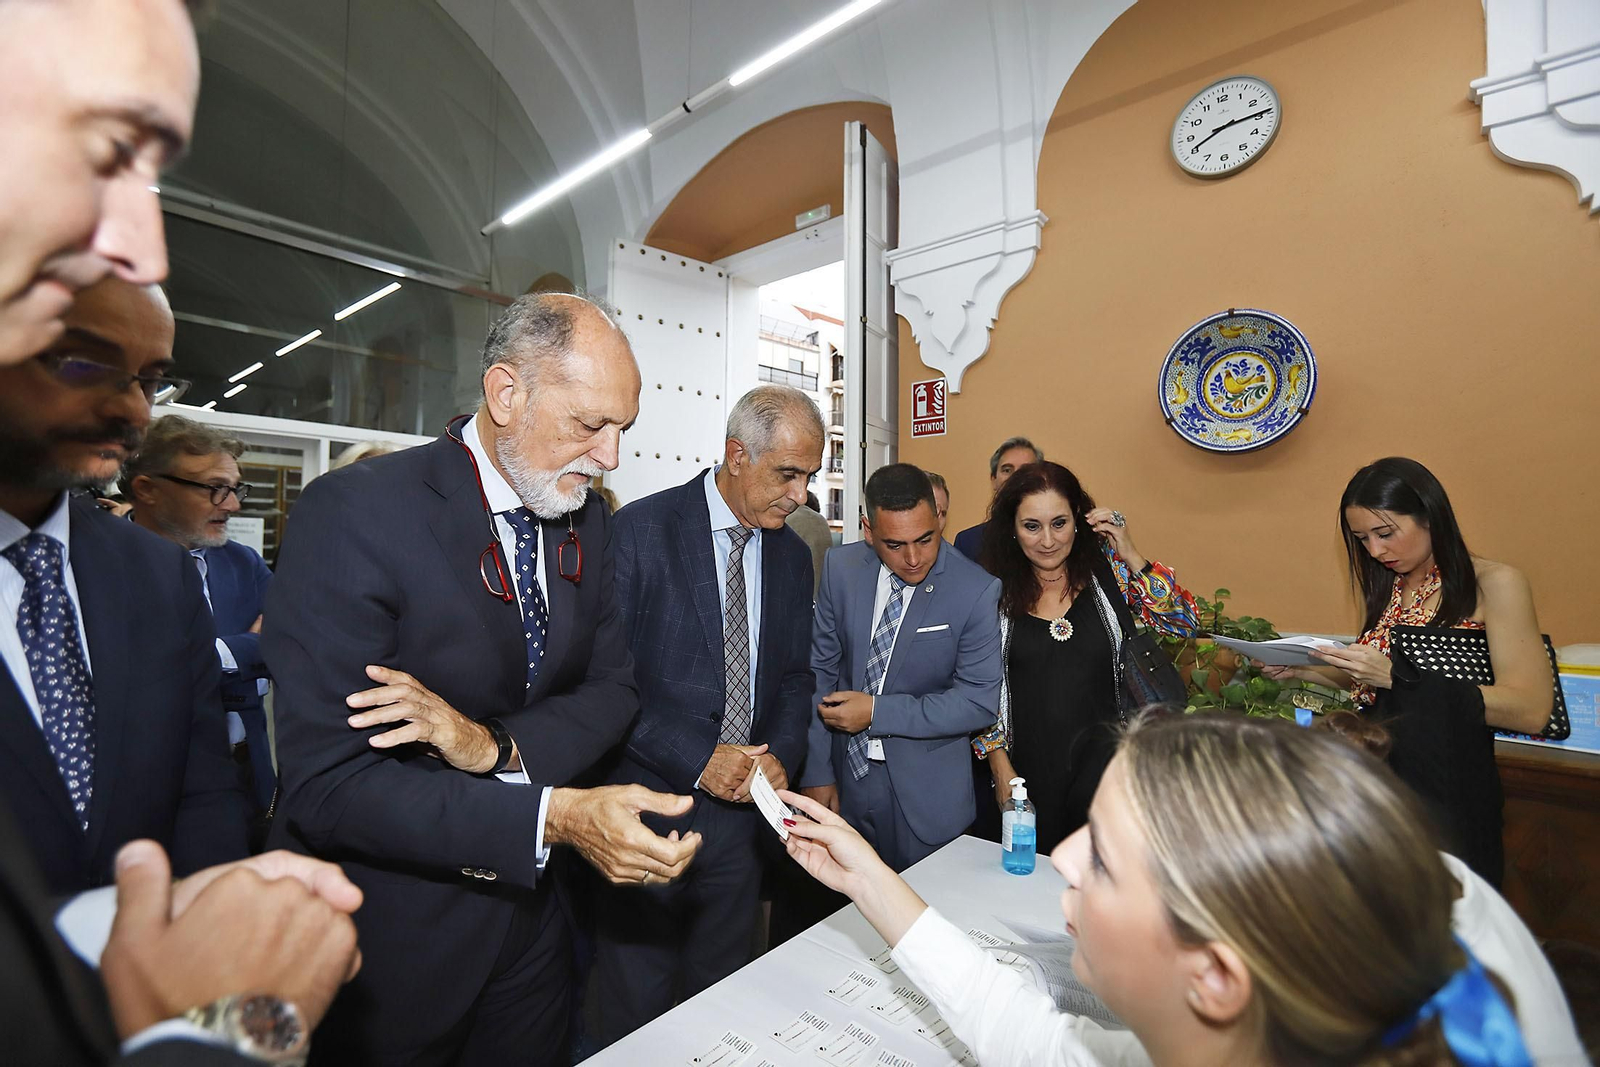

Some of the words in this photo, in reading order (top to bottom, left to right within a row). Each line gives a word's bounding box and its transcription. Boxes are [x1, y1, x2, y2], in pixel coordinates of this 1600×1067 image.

[1216, 94, 1229, 103] 12
[1248, 99, 1258, 107] 2
[1254, 112, 1264, 121] 3
[1190, 119, 1202, 127] 10
[1250, 128, 1259, 136] 4
[1190, 146, 1200, 155] 8
[1239, 143, 1248, 151] 5
[1203, 154, 1212, 162] 7
[1220, 154, 1229, 162] 6
[914, 421, 944, 433] EXTINTOR
